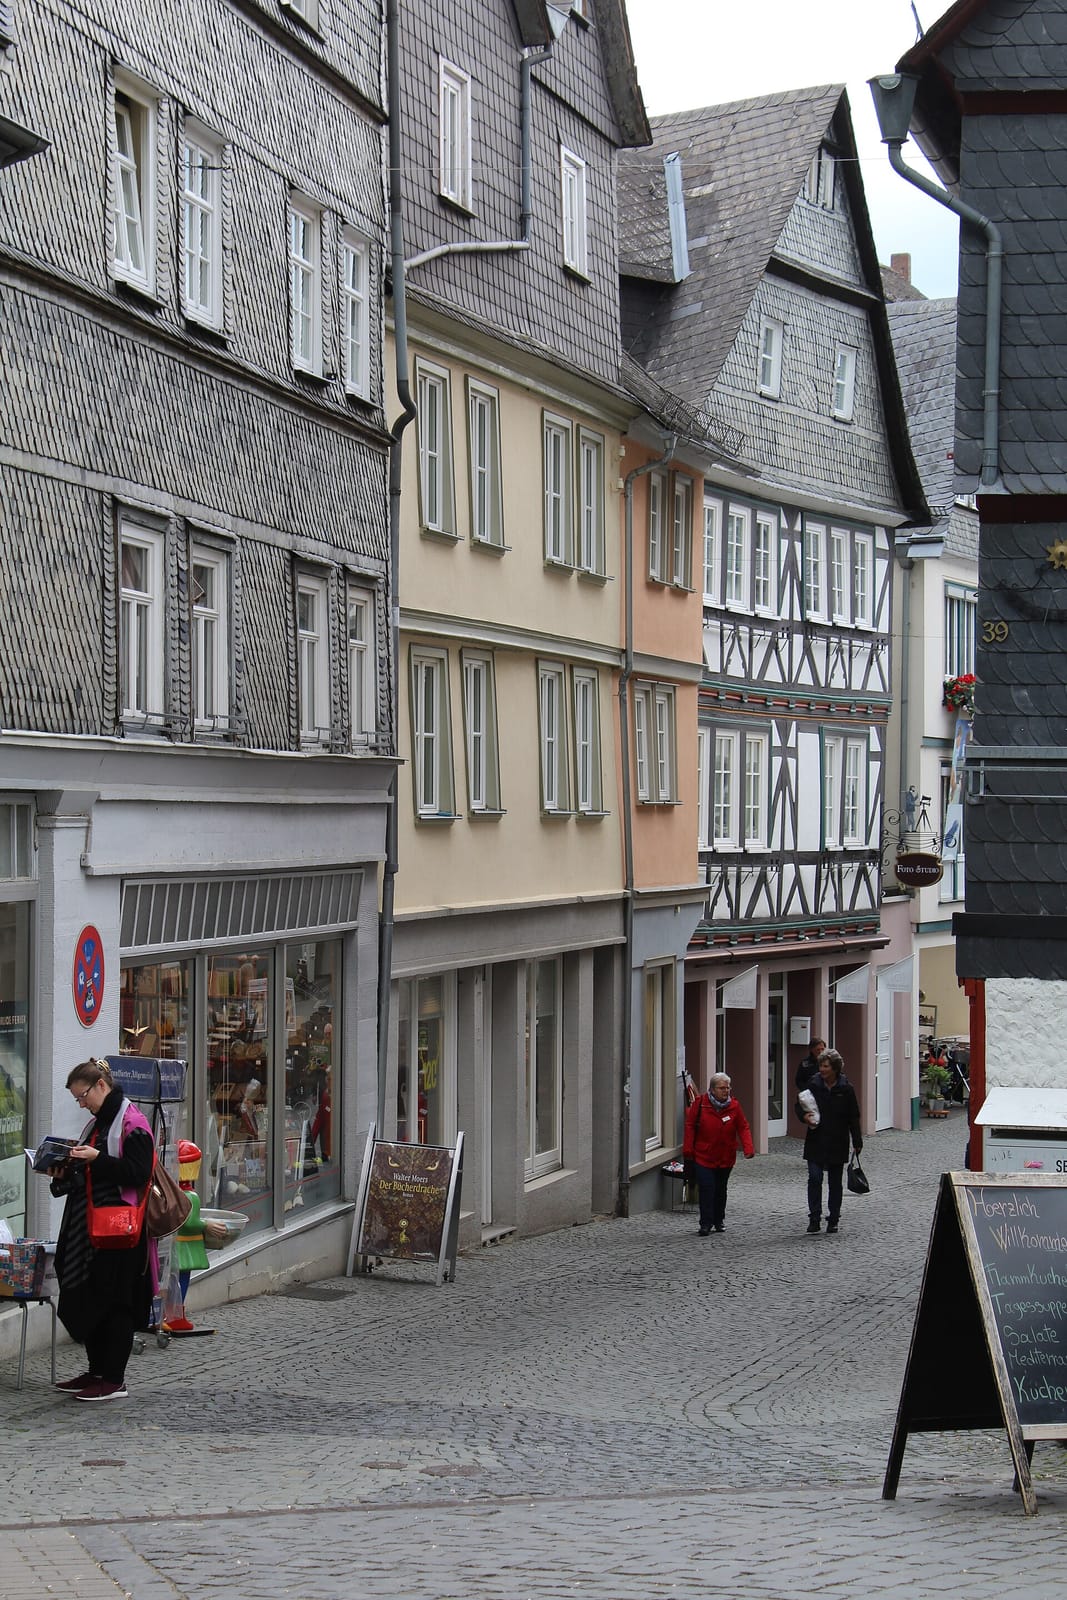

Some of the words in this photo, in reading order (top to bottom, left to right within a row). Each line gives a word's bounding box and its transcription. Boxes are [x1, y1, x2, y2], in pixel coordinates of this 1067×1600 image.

[982, 621, 1009, 643] 39
[379, 1180, 393, 1190] Der
[393, 1181, 440, 1195] Bücherdrache
[393, 1172, 411, 1182] Walter
[411, 1173, 428, 1183] Moers
[1003, 1324, 1060, 1346] Salate
[1013, 1375, 1067, 1404] Kuche
